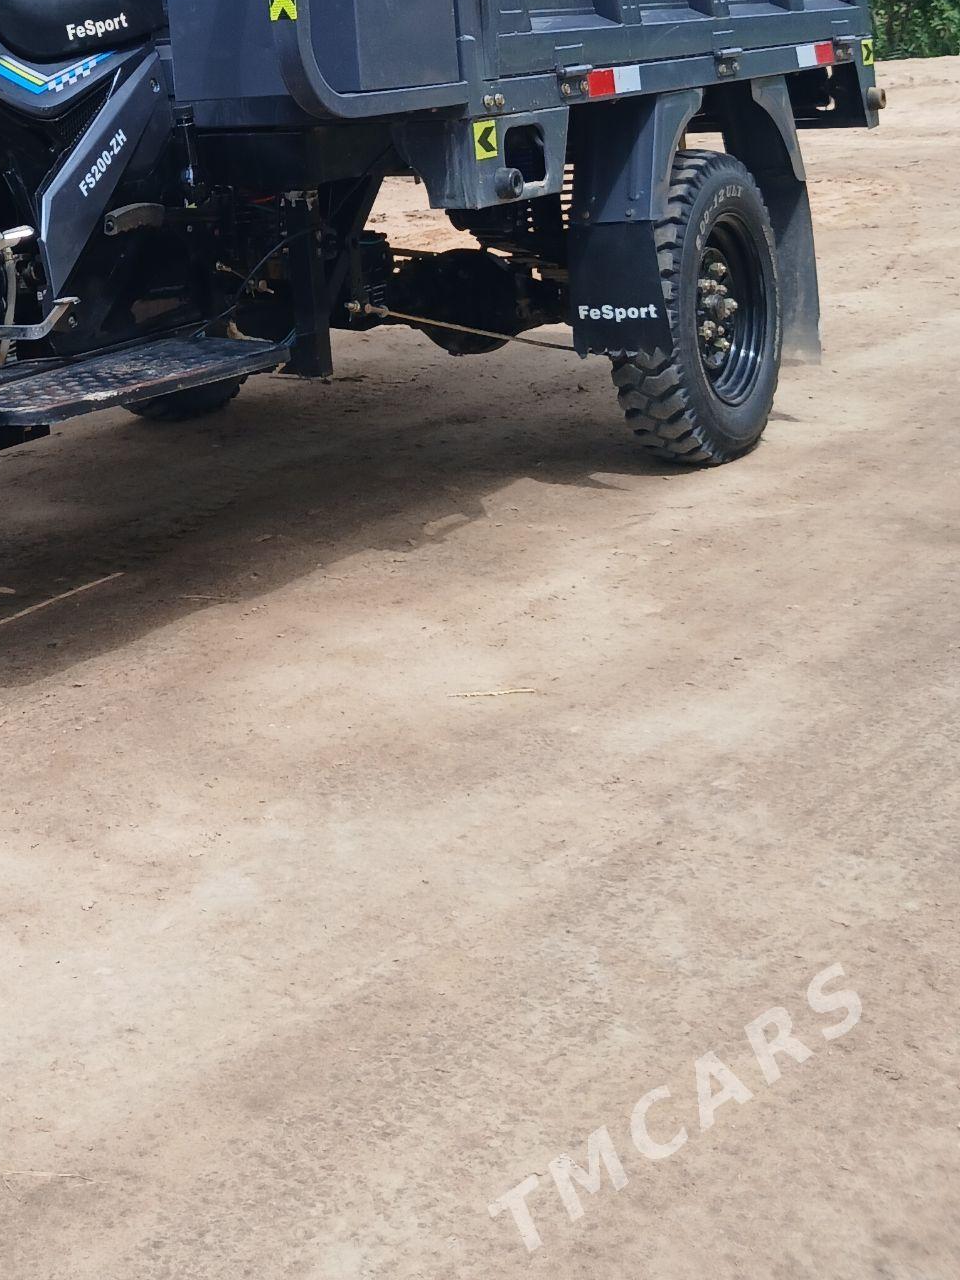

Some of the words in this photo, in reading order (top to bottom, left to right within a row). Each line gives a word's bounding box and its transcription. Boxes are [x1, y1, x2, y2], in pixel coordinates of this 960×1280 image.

[66, 12, 128, 41] FeSport
[78, 128, 128, 197] FS200-ZH
[578, 304, 658, 322] FeSport
